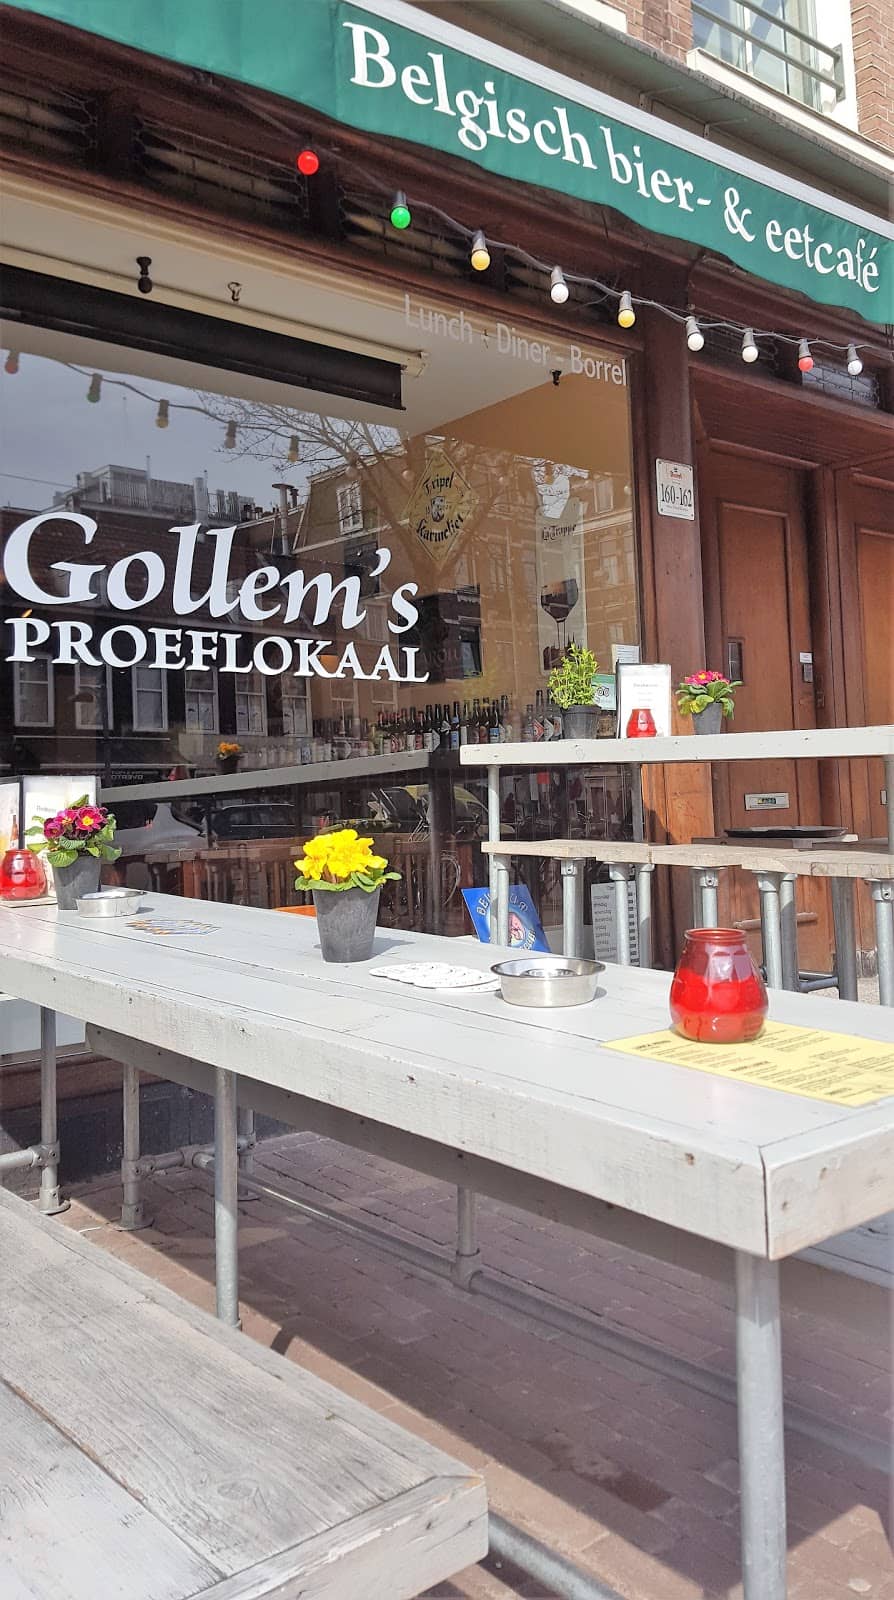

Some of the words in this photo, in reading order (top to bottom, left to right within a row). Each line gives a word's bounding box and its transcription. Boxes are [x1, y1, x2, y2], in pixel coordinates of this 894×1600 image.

[343, 22, 597, 170] Belgisch
[600, 126, 712, 212] bier-
[723, 187, 756, 242] &
[765, 218, 880, 293] eetcafé
[404, 294, 473, 344] Lunch
[495, 322, 551, 366] Diner
[570, 344, 627, 387] Borrel
[423, 471, 455, 495] Tripel
[660, 483, 692, 507] 160-162
[3, 511, 419, 634] Gollem's
[4, 617, 430, 683] PROEFLOKAAL
